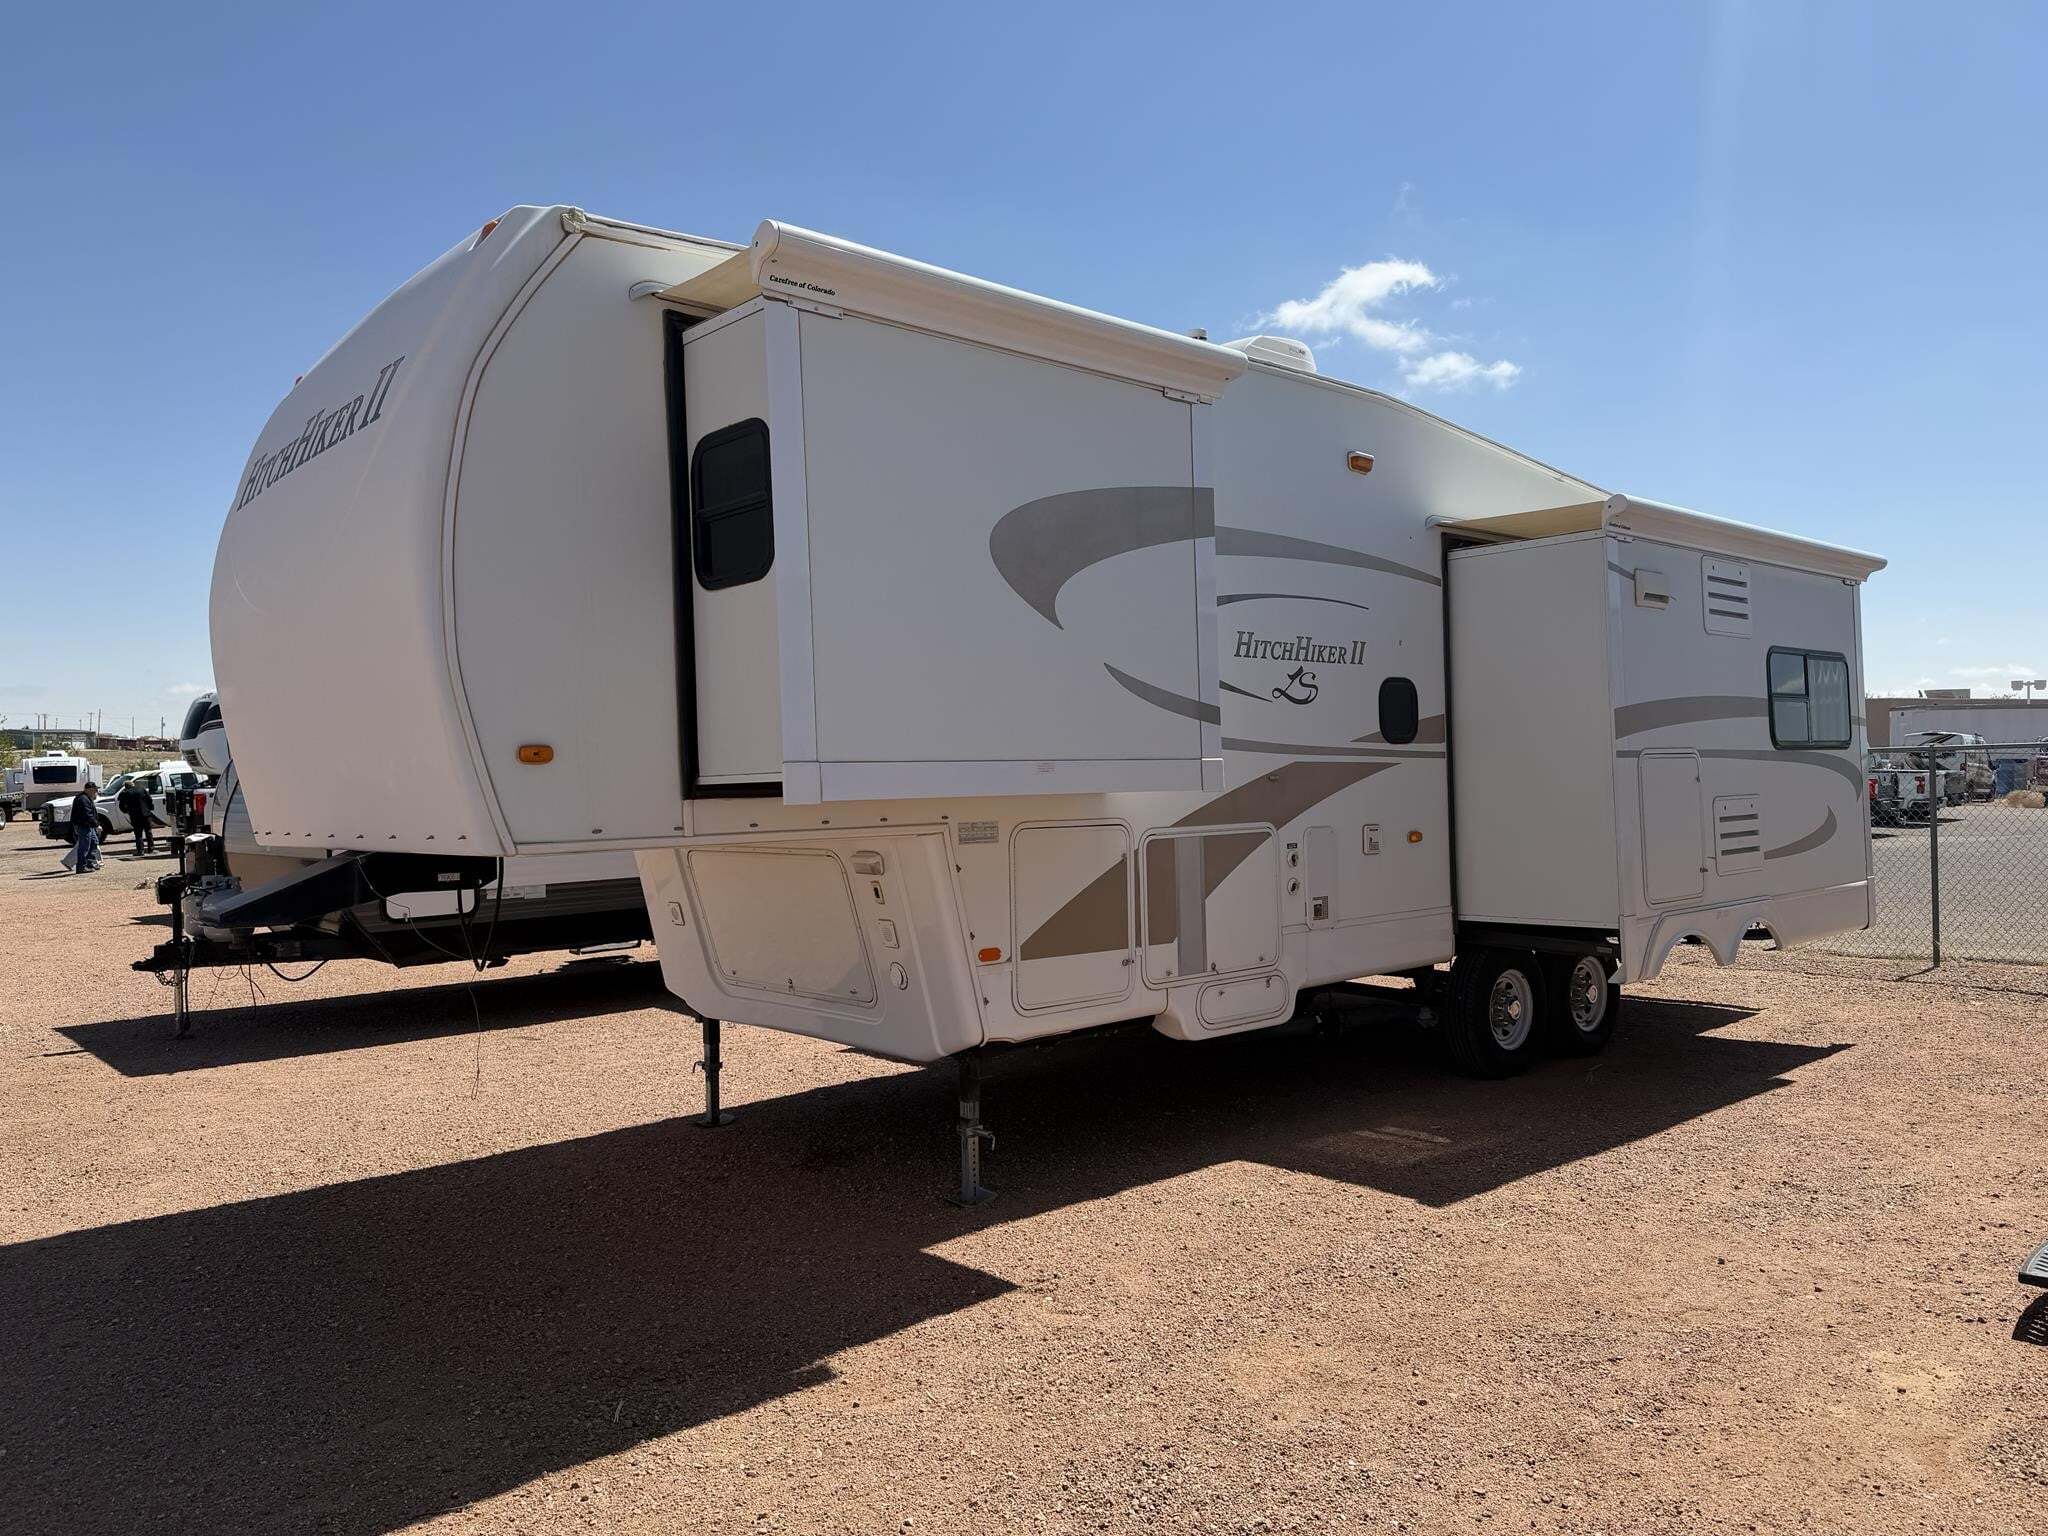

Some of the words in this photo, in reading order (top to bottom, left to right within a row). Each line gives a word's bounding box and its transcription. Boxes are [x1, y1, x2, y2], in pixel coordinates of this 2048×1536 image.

[769, 275, 798, 286] Carefree
[807, 283, 836, 296] Colorado
[358, 355, 406, 431] II
[1349, 639, 1367, 665] II
